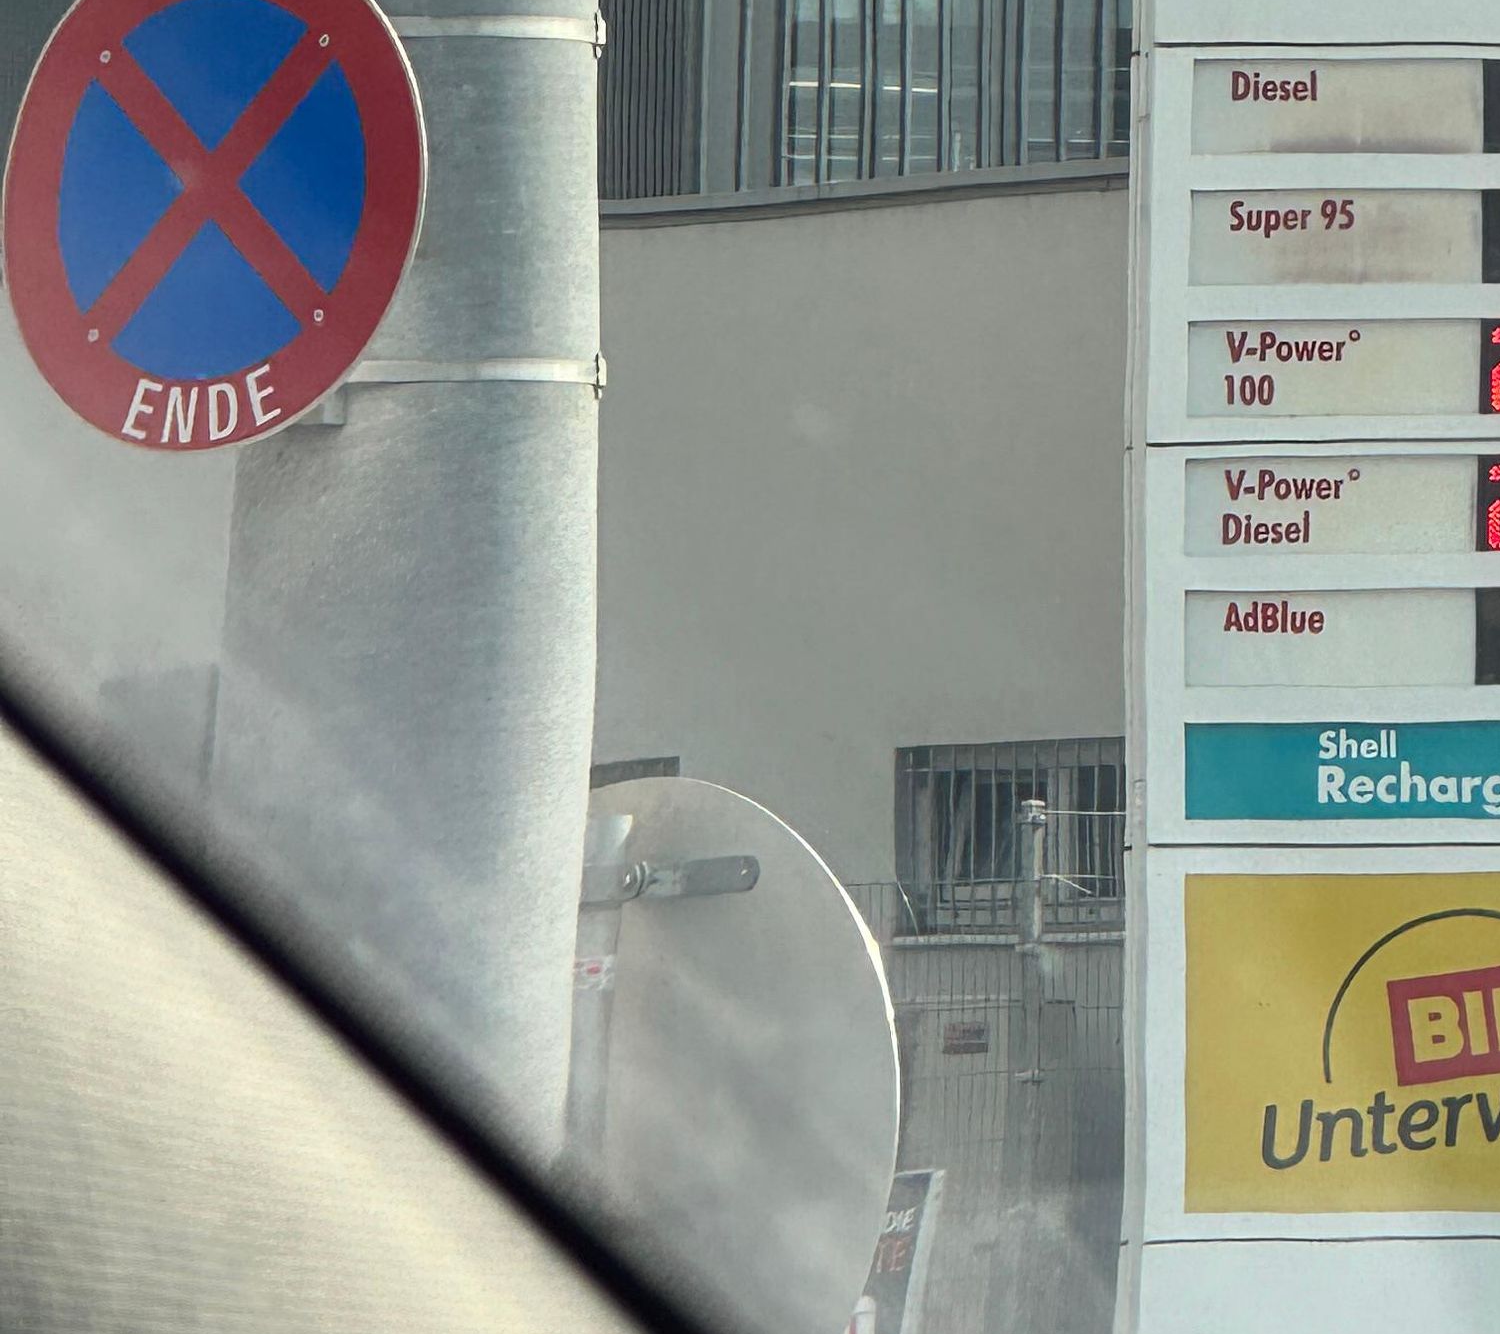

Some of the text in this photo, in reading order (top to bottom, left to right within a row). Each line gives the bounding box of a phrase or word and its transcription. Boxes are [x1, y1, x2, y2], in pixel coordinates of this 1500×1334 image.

[1230, 69, 1318, 102] Diesel
[1230, 199, 1355, 238] Super 95
[121, 363, 282, 444] ENDE
[1224, 374, 1275, 406] 100
[1221, 510, 1310, 545] Diesel
[1223, 601, 1325, 634] AdBlue
[1317, 728, 1397, 760] Shell
